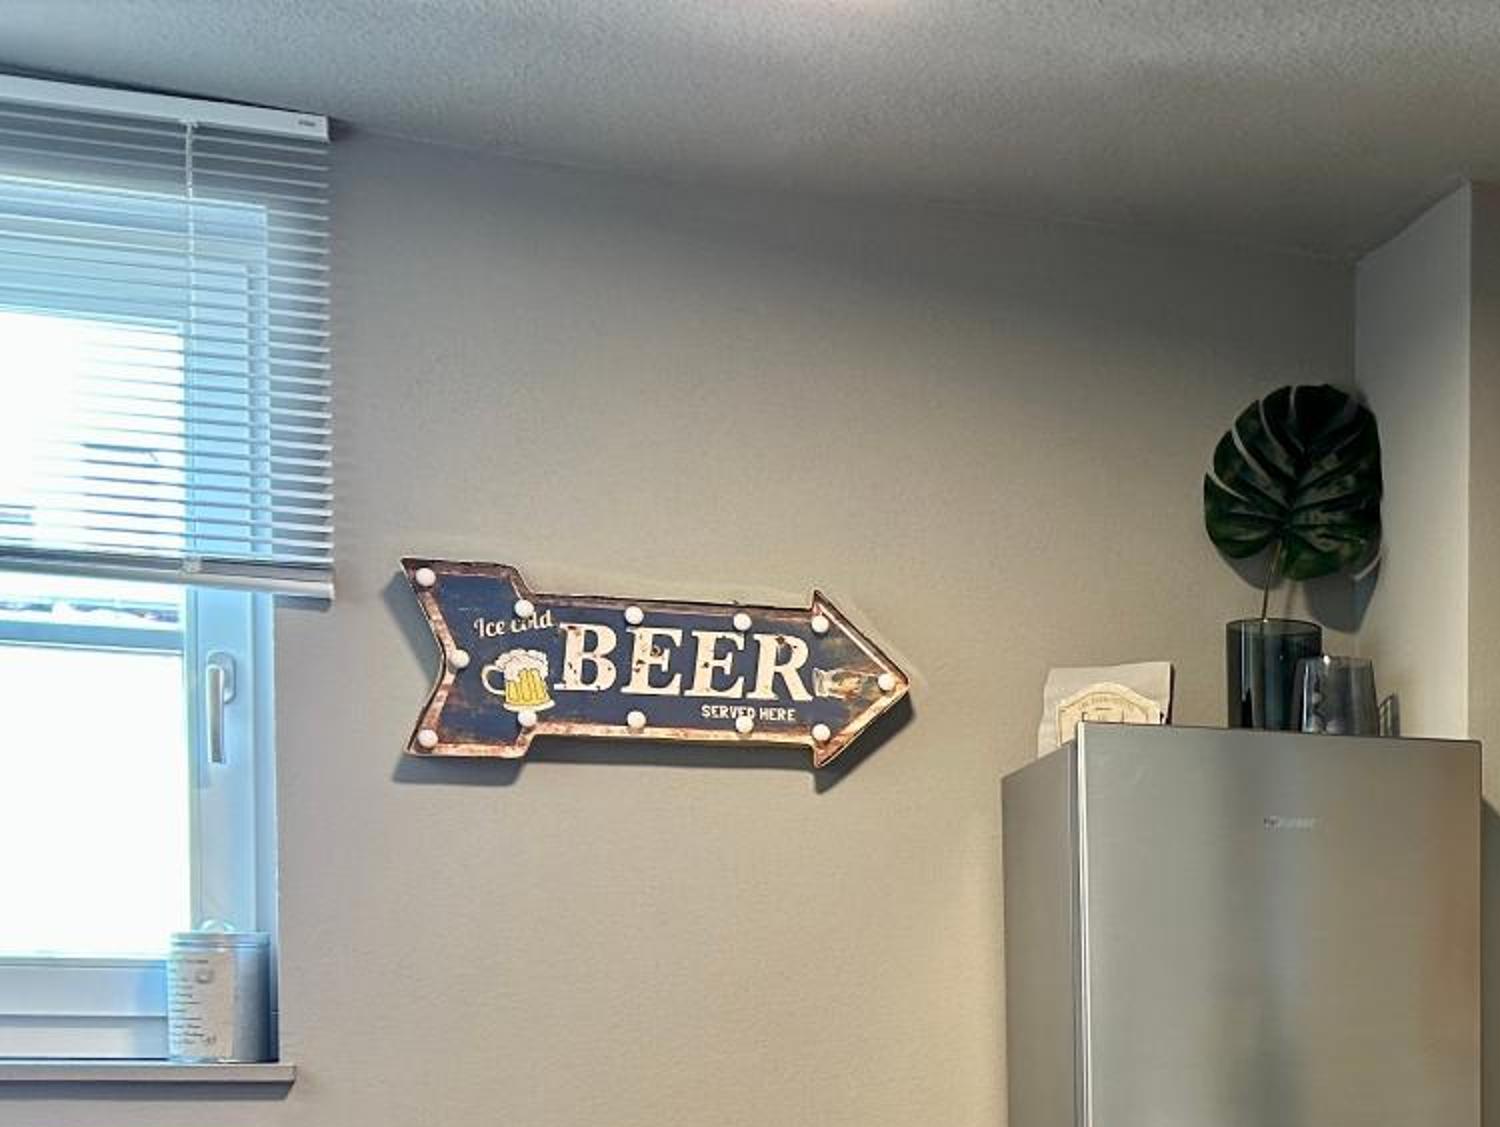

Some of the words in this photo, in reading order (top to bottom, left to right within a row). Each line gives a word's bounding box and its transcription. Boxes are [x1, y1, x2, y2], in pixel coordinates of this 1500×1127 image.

[473, 618, 505, 637] Ice
[553, 622, 814, 702] BEER
[701, 704, 757, 720] SERVED
[758, 707, 798, 721] HERE
